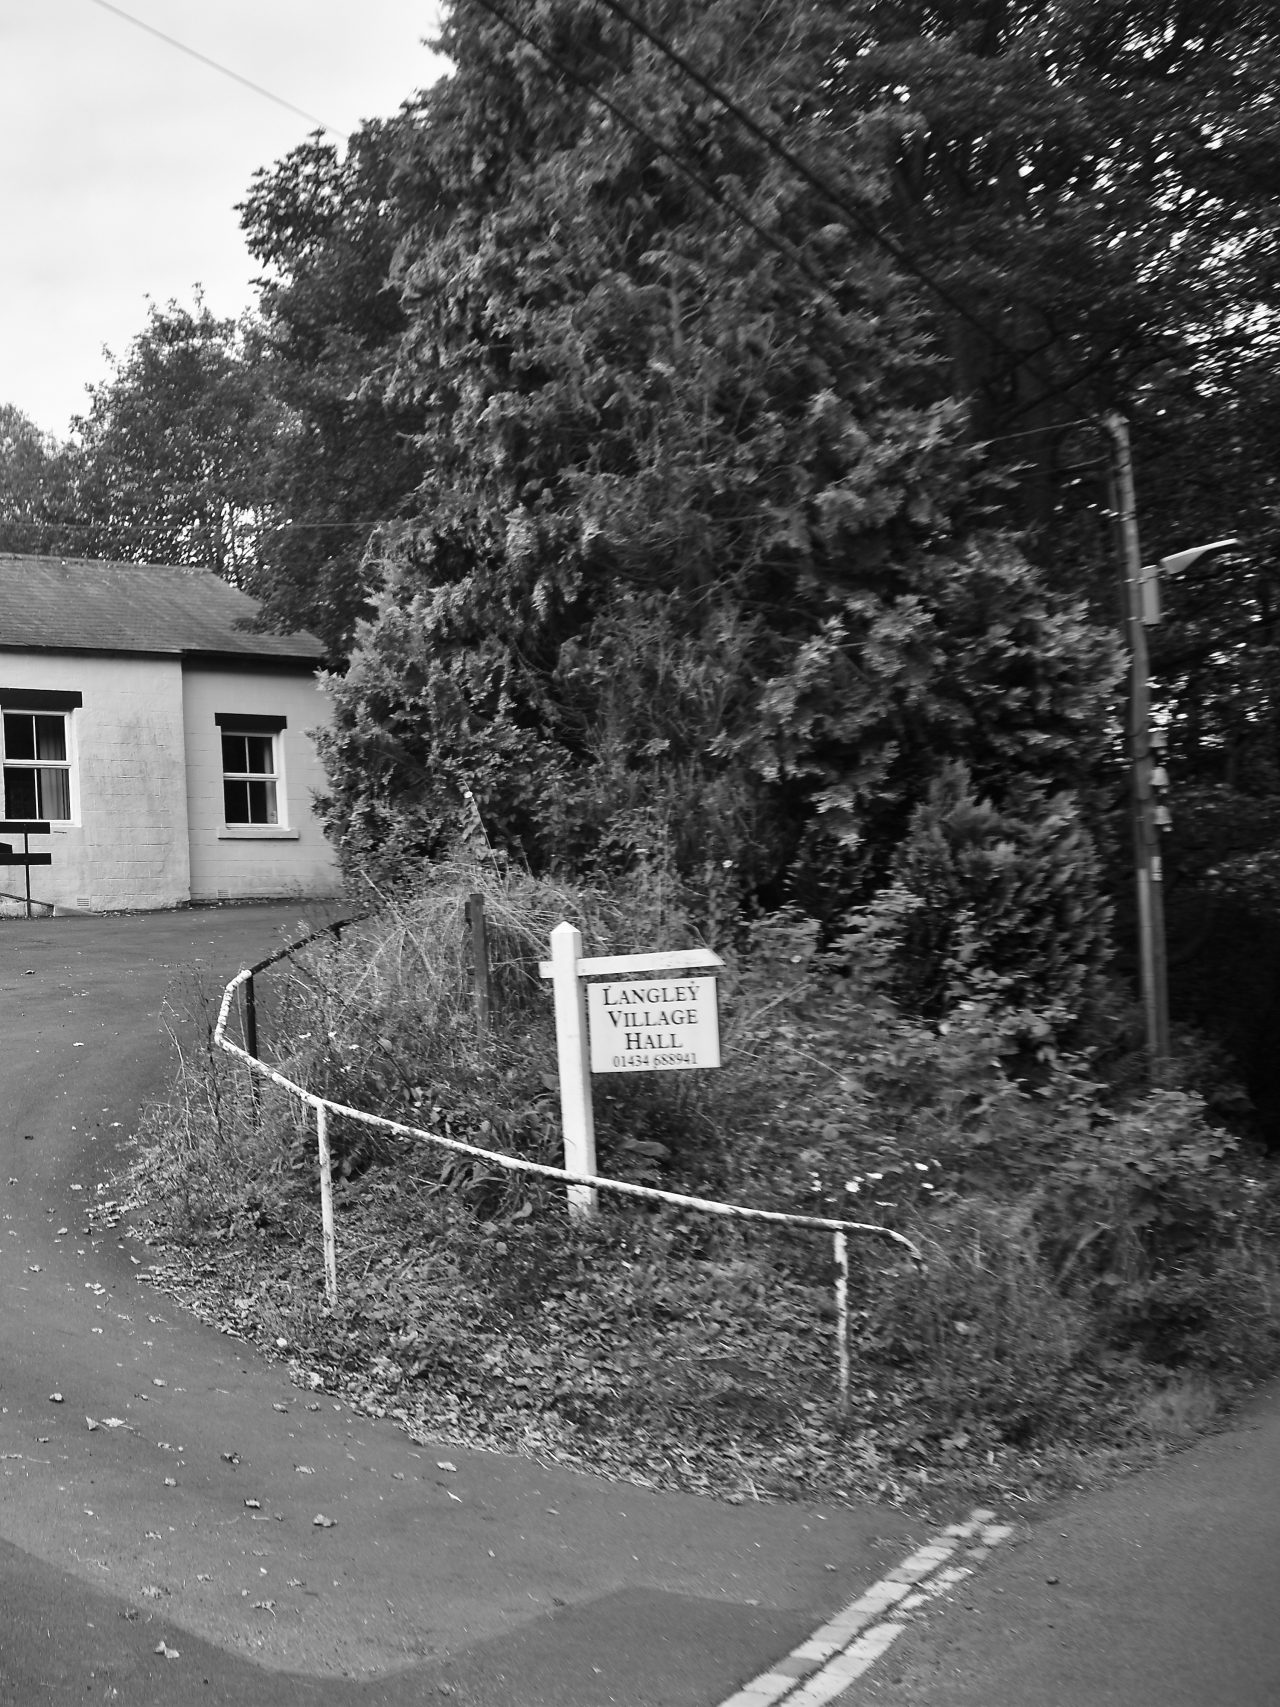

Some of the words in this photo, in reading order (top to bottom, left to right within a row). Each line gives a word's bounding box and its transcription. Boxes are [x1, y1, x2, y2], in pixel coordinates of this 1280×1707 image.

[603, 985, 700, 1006] LANGLEY
[608, 1009, 698, 1028] VILLAGE
[625, 1032, 683, 1050] HALL
[613, 1055, 649, 1067] 01434
[654, 1053, 698, 1067] 688941
